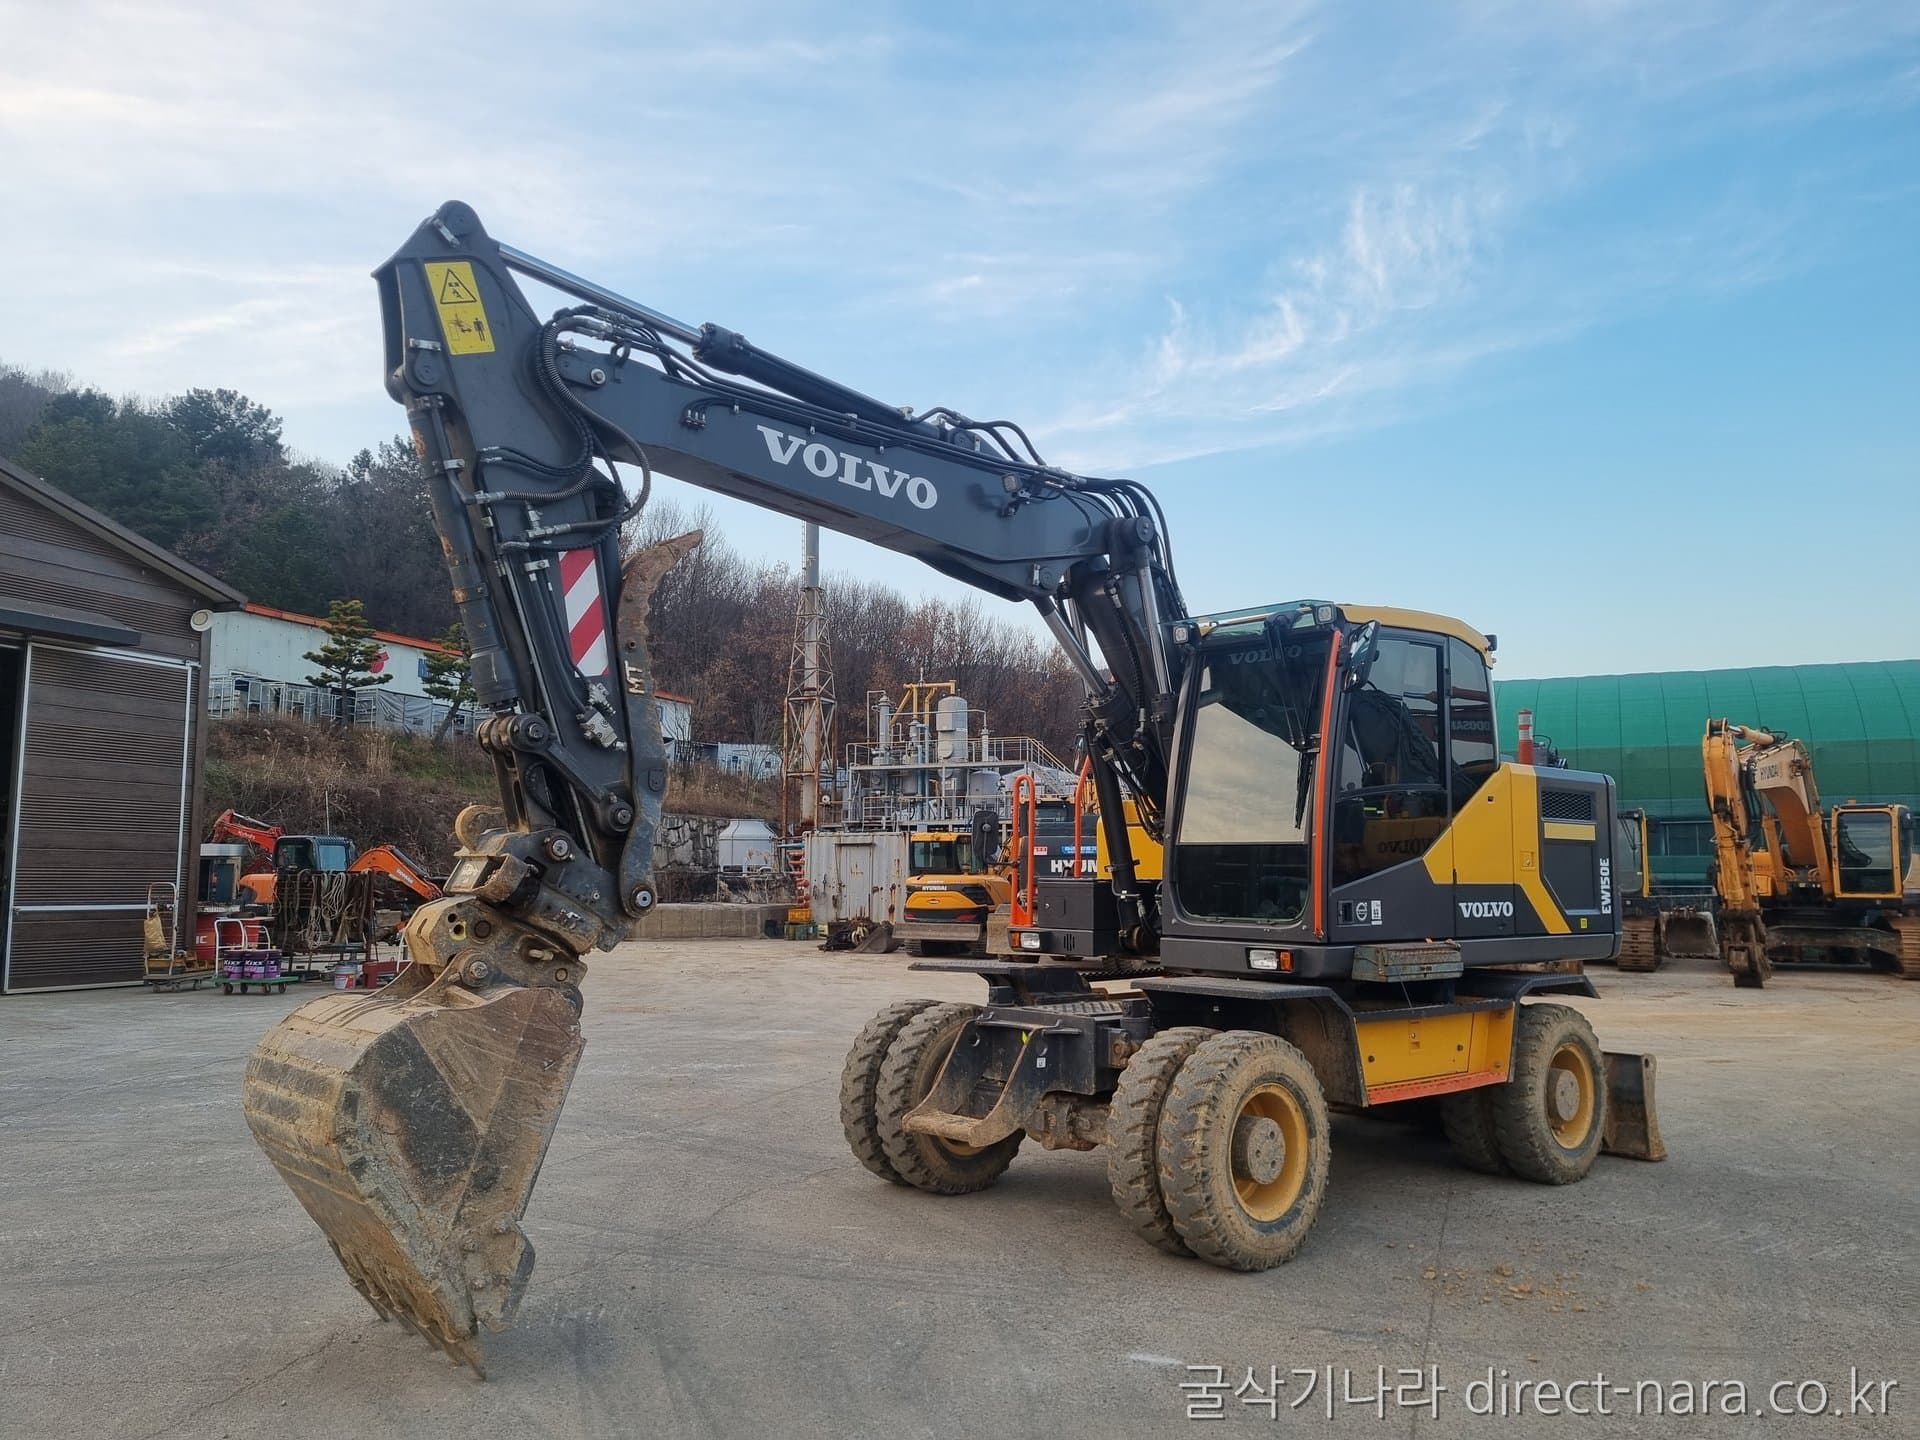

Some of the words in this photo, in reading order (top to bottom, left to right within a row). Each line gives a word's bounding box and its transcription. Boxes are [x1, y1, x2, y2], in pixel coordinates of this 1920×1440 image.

[756, 424, 938, 510] VOLVO
[1458, 901, 1514, 918] VOLVO
[1600, 858, 1611, 914] EW150E
